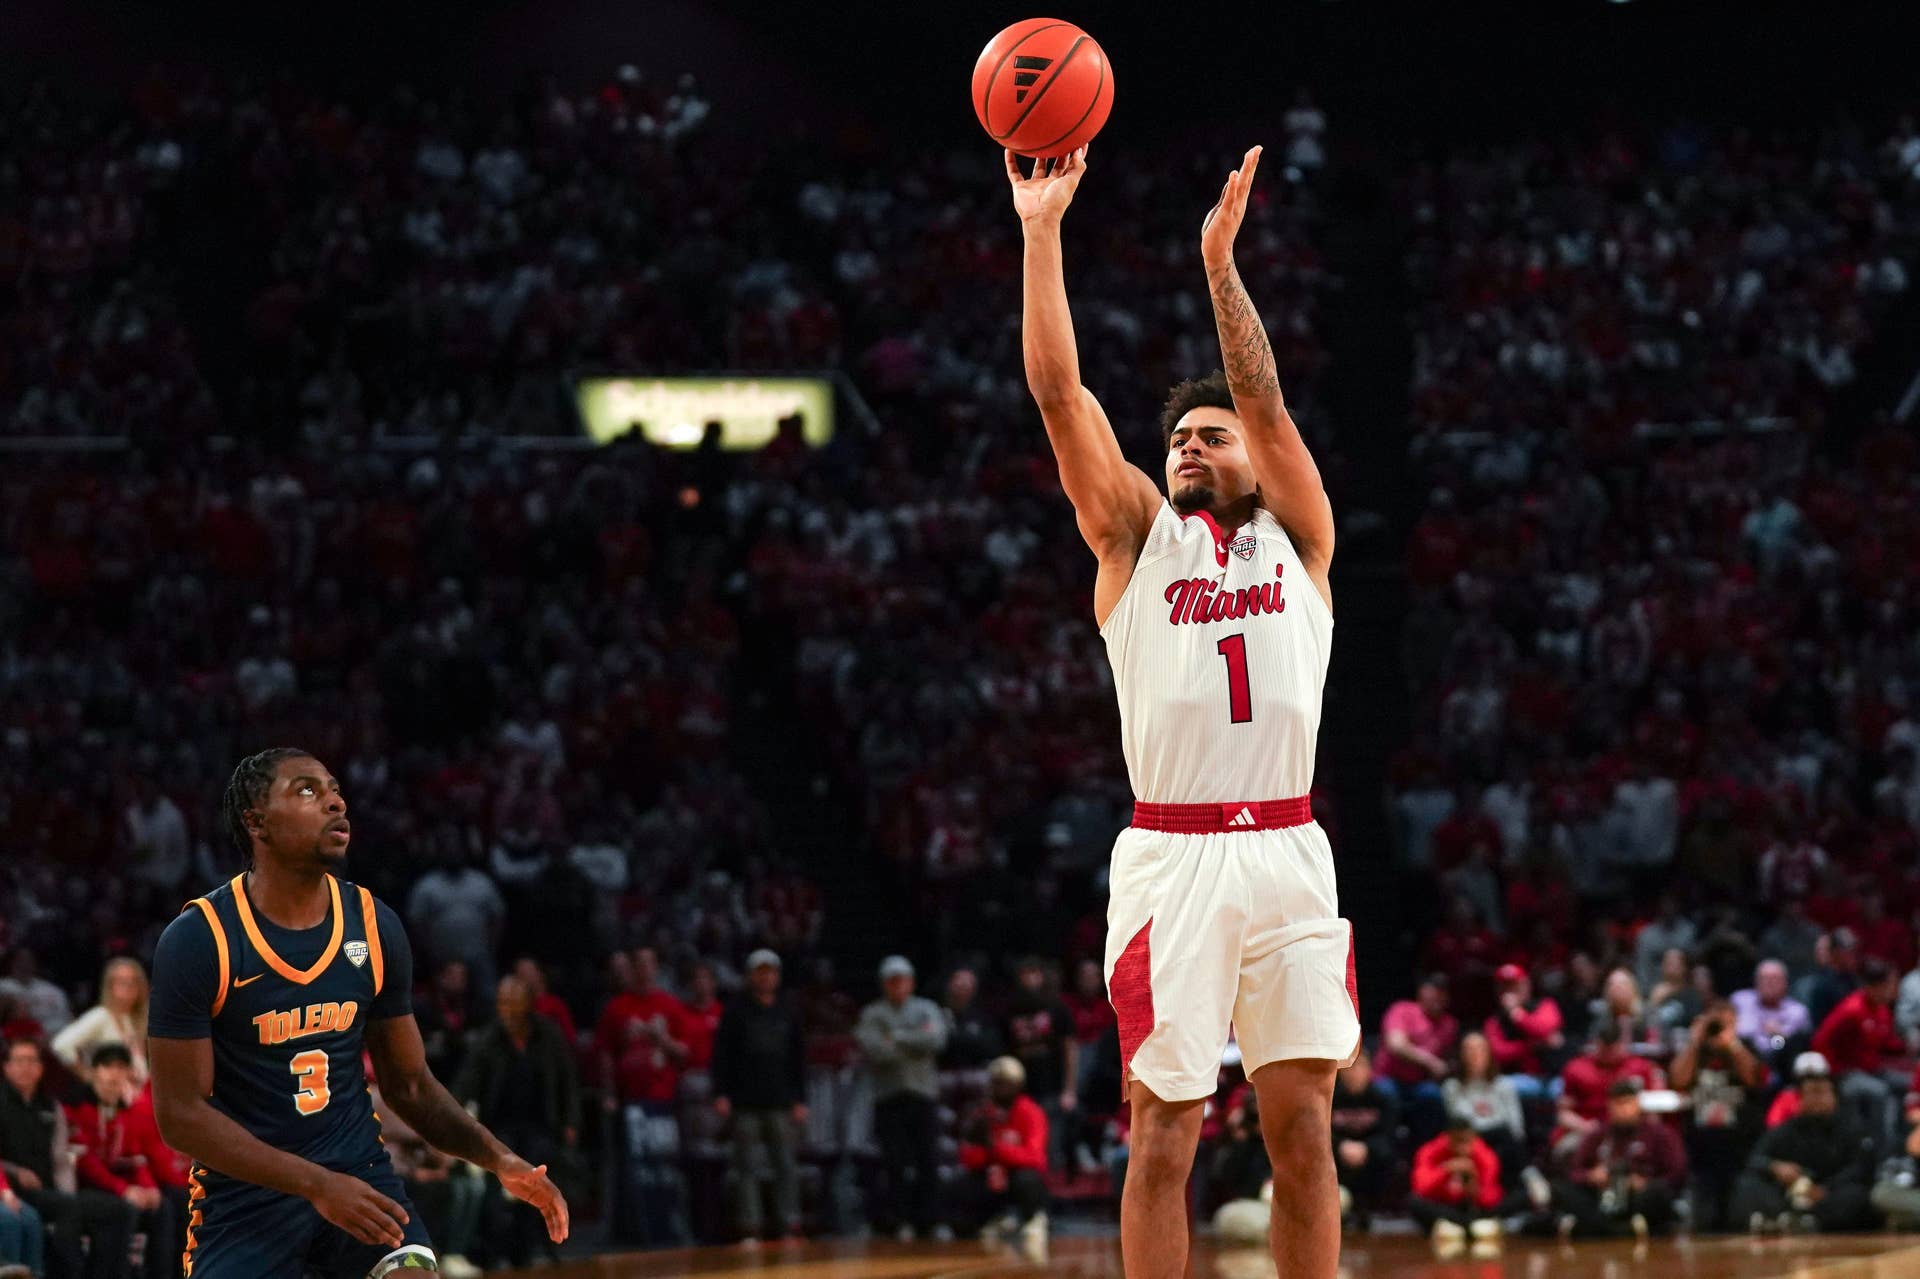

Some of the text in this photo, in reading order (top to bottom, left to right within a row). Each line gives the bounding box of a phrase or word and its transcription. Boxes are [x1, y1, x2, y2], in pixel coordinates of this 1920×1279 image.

[1232, 541, 1256, 553] MAC
[1164, 563, 1286, 626] Miami
[1217, 633, 1252, 724] 1
[347, 947, 368, 957] MAC
[252, 1001, 358, 1045] TOLEDO
[290, 1049, 330, 1116] 3
